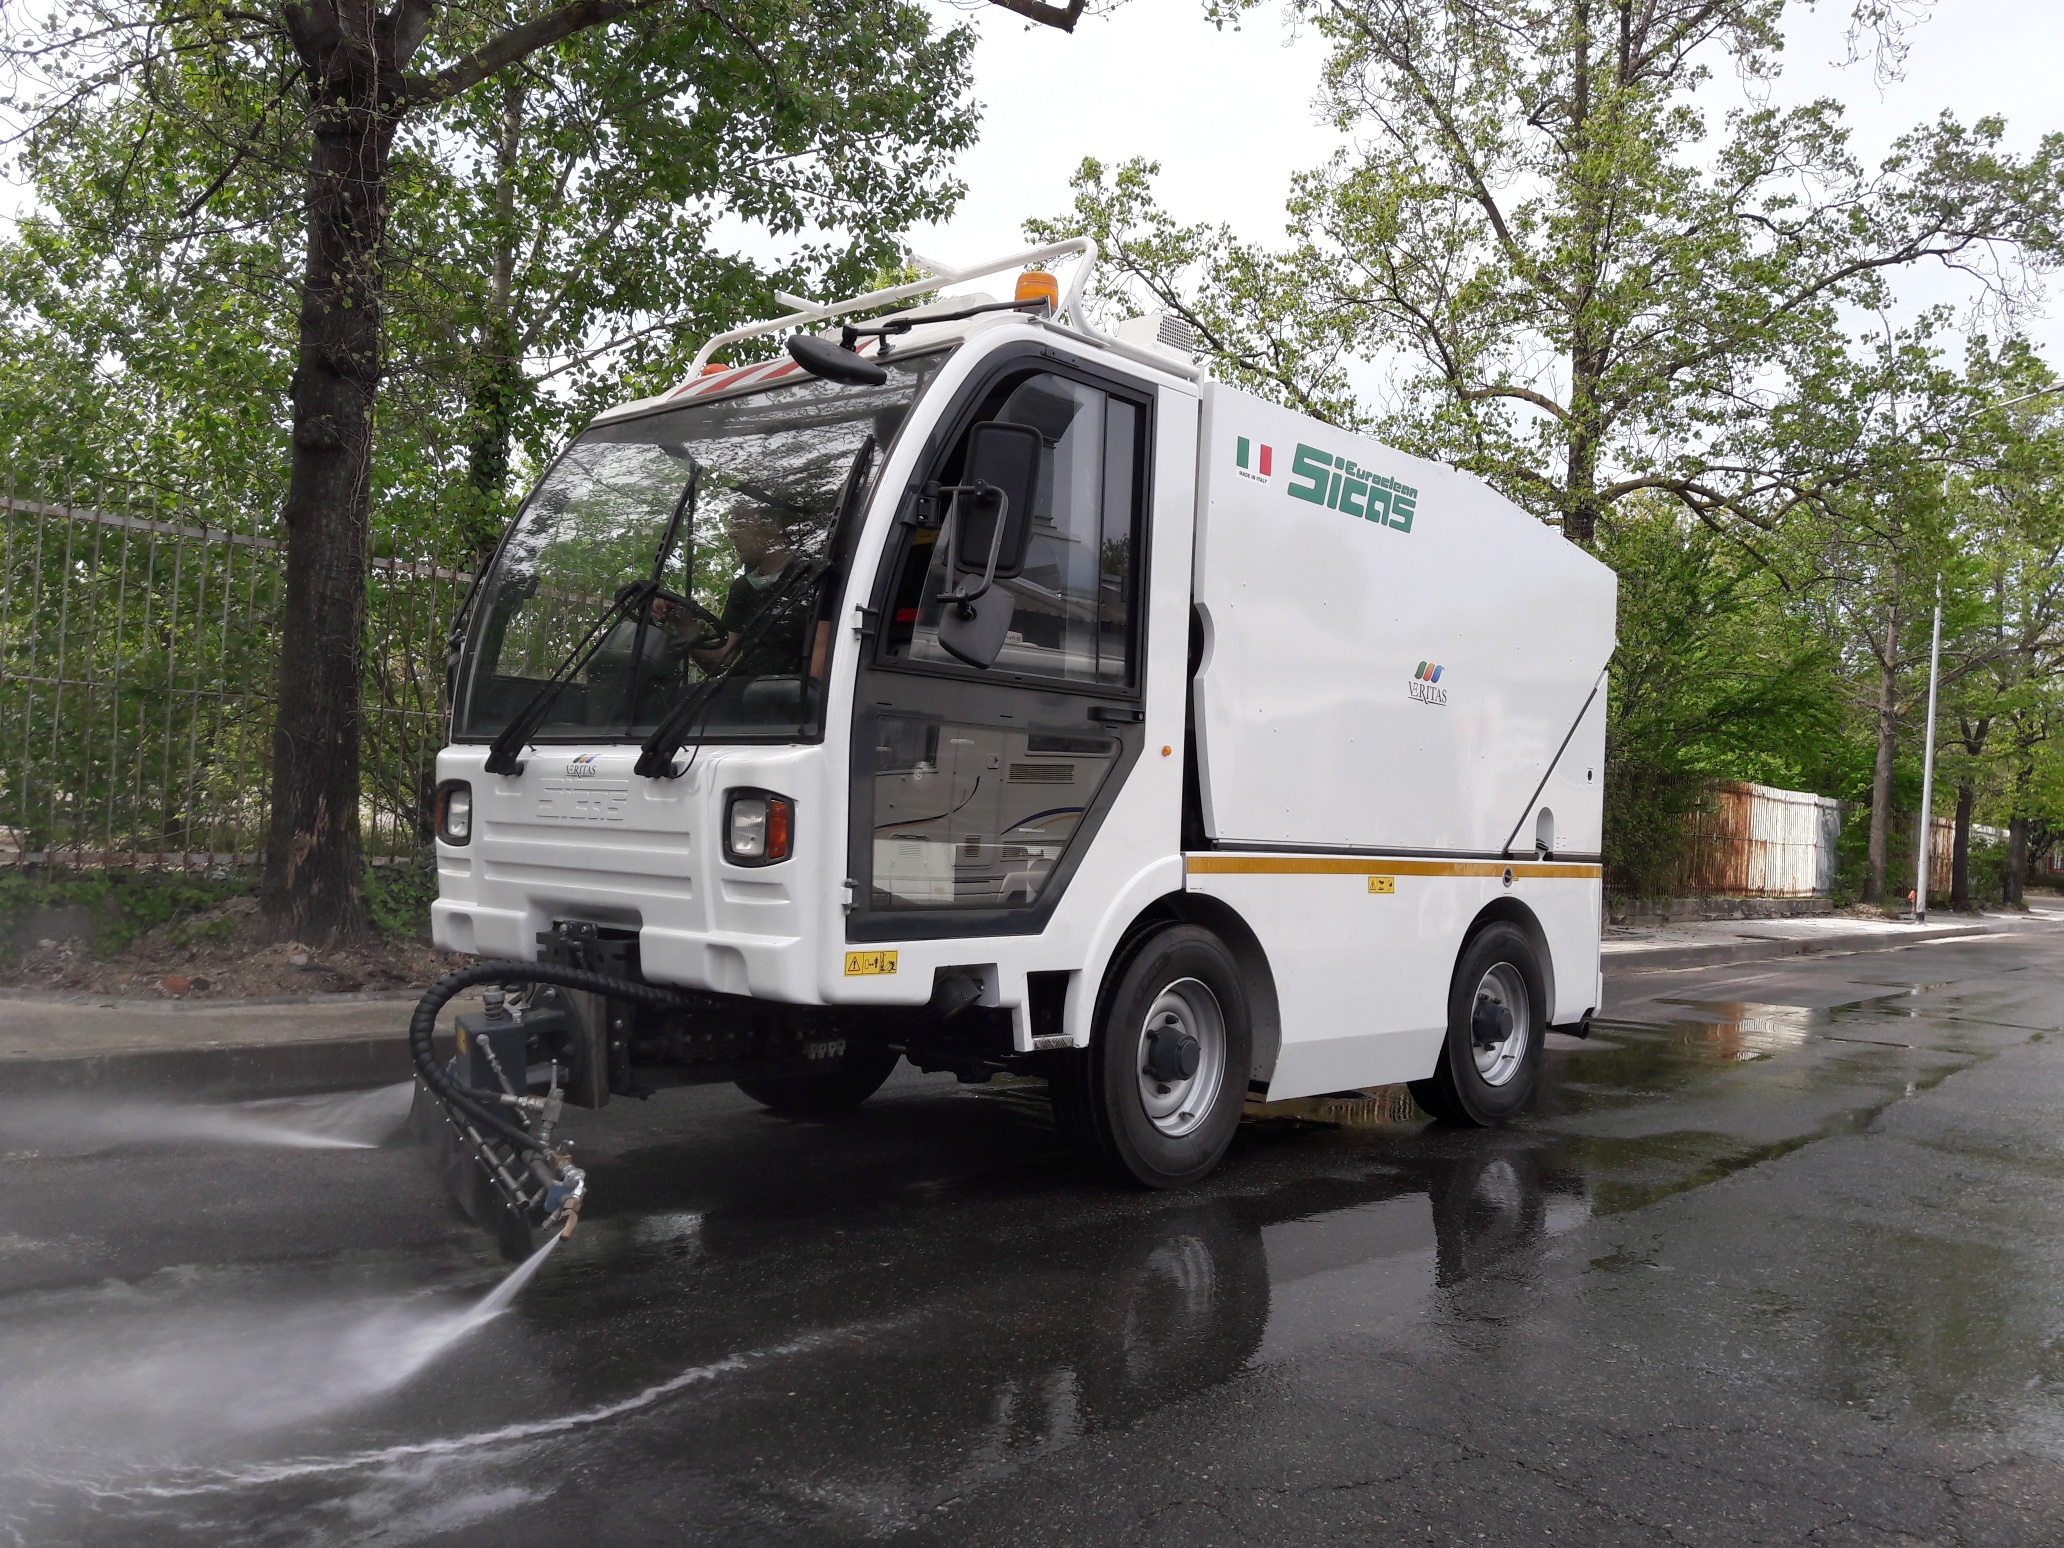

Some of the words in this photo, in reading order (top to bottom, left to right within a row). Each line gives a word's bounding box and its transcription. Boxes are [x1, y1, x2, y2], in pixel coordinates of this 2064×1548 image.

[1239, 471, 1251, 479] MADE
[1256, 476, 1267, 484] ITALY
[1345, 460, 1418, 499] Euroclean
[1408, 681, 1447, 704] VERITAS
[566, 765, 597, 778] VERITAS
